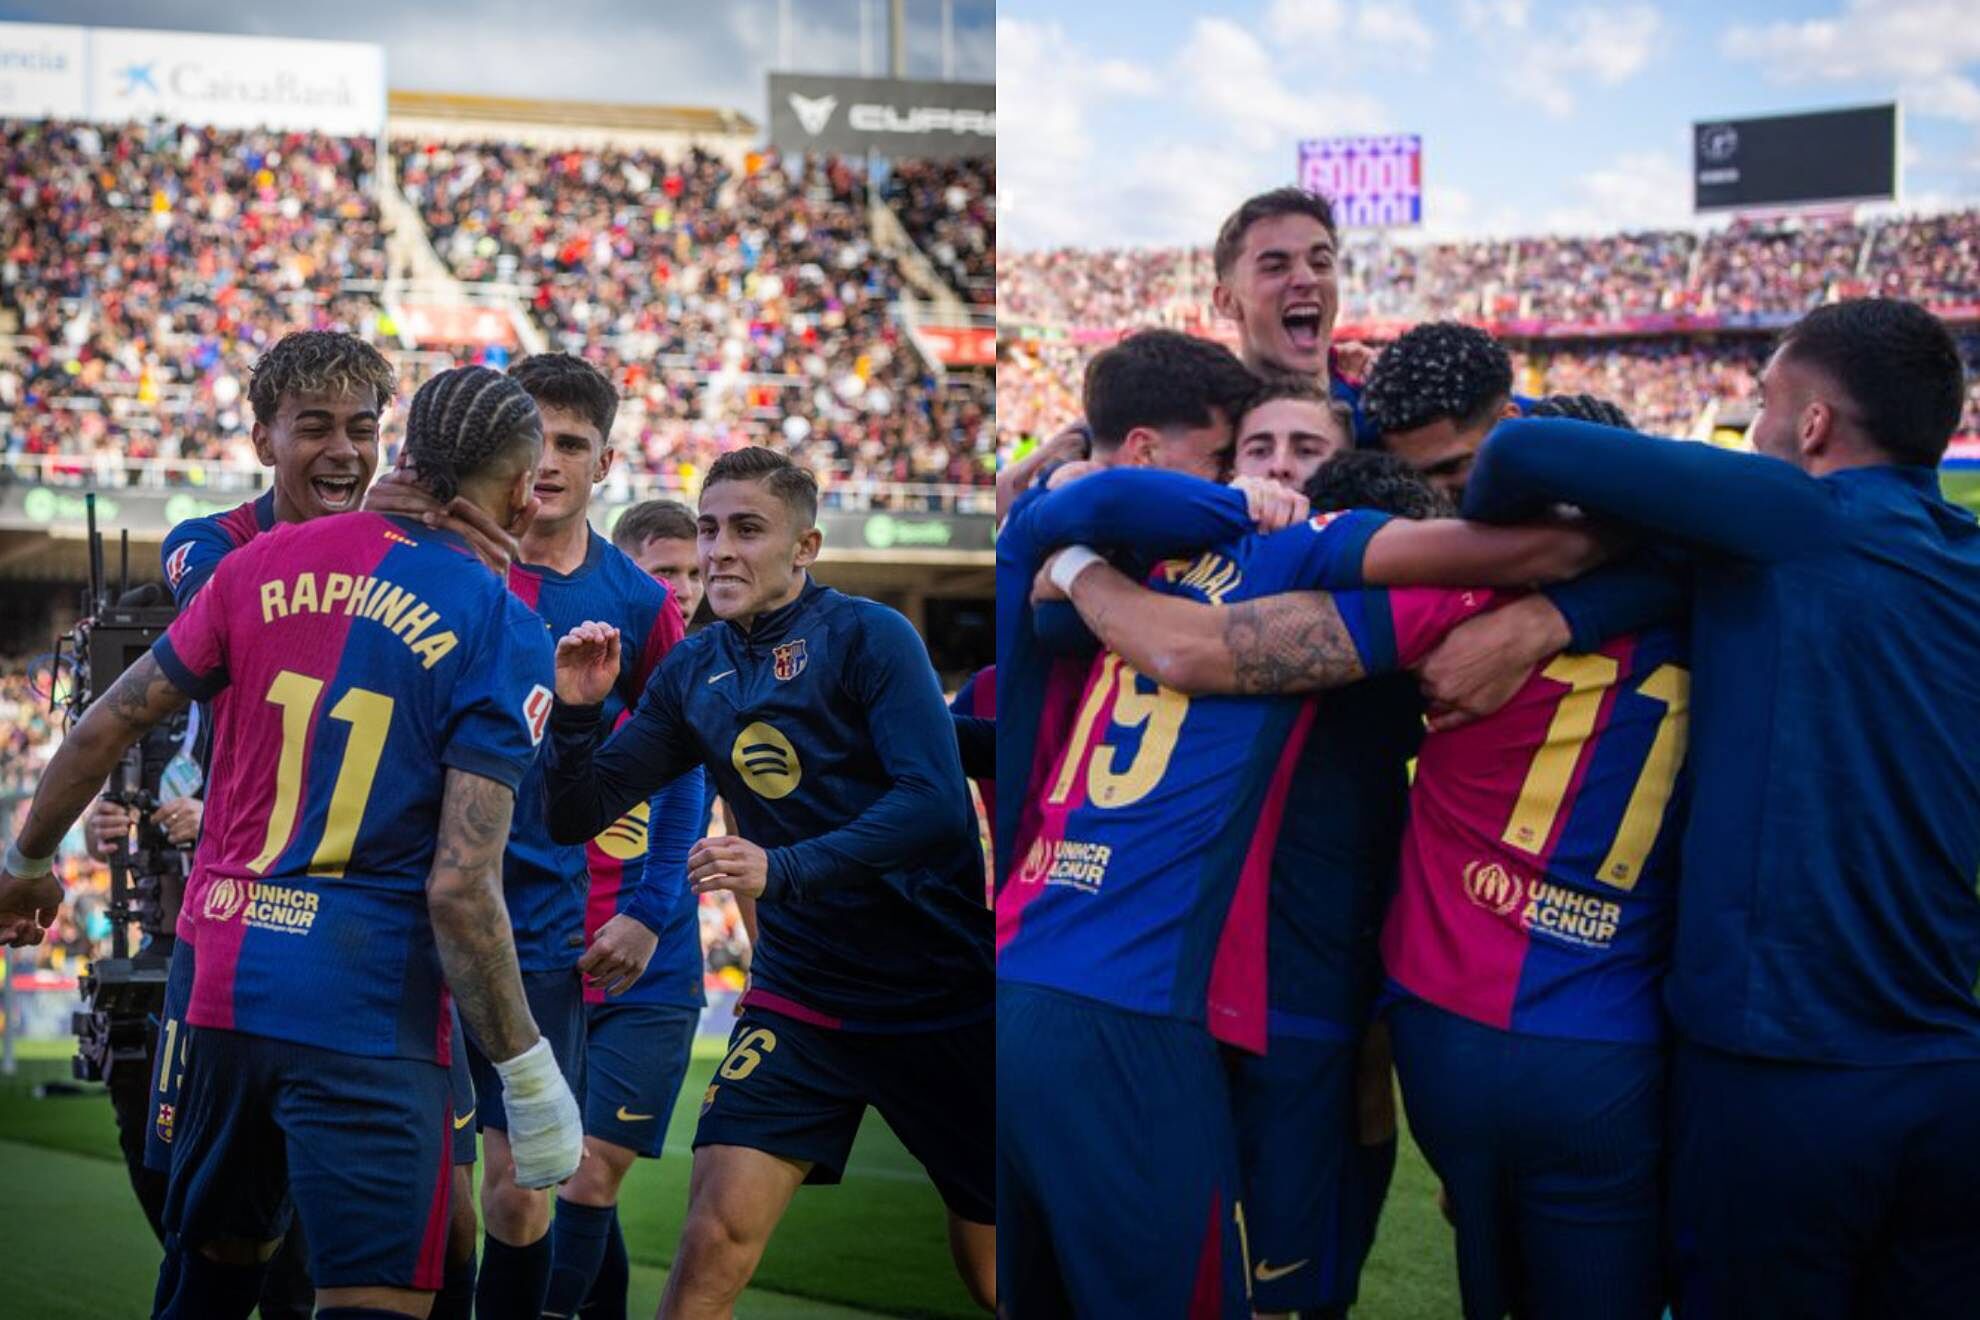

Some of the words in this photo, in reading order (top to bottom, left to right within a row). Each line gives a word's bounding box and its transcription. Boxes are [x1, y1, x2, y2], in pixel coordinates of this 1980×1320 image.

[848, 103, 996, 137] CUPR
[260, 572, 460, 671] RAPHINHA
[1047, 650, 1191, 810] 19
[245, 669, 395, 880] 11
[1501, 652, 1691, 892] 11
[242, 901, 316, 928] ACNUR
[248, 880, 319, 912] UNHCR
[1527, 879, 1621, 924] UNHCR
[1520, 901, 1617, 941] ACNUR
